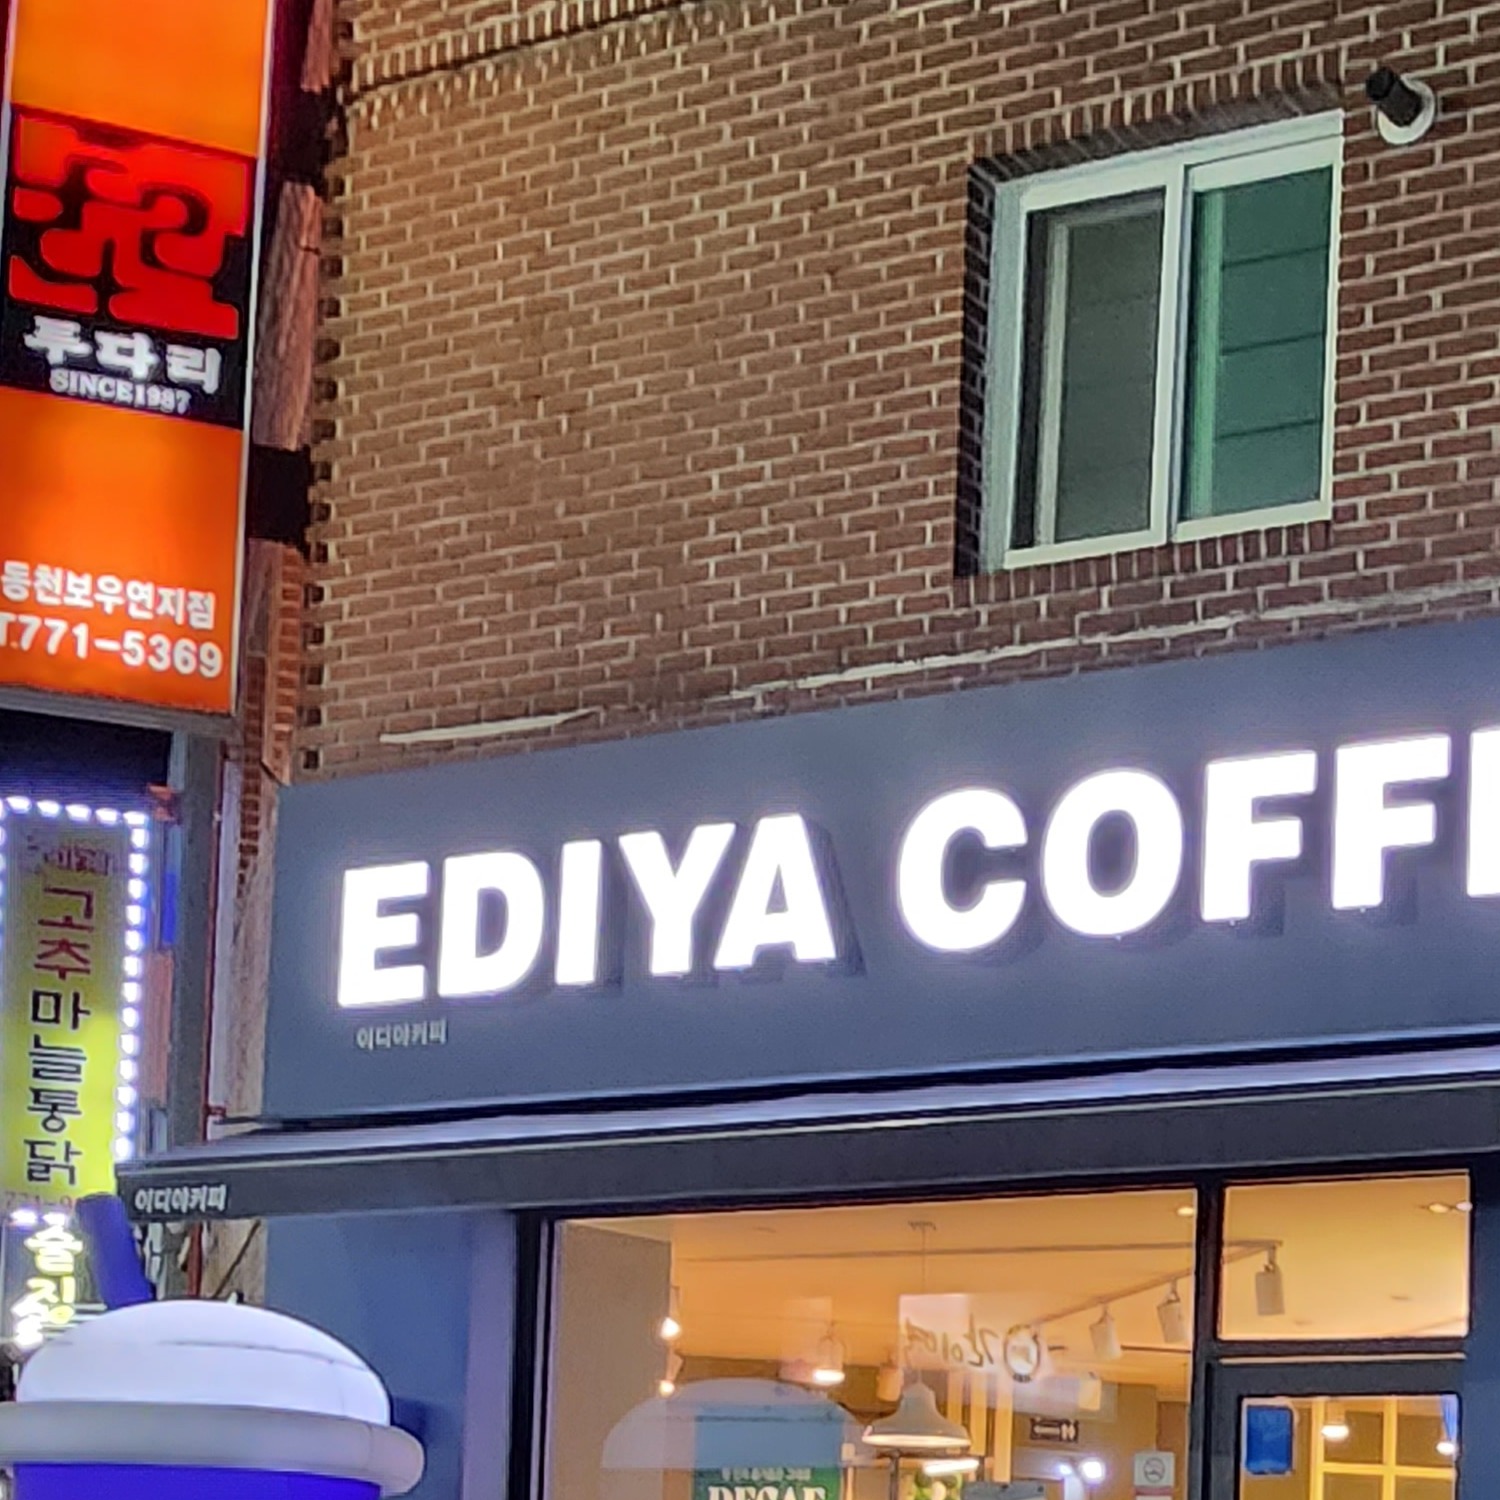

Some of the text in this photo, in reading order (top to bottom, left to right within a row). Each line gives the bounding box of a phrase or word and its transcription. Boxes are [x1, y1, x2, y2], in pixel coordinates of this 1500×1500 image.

[336, 812, 837, 1008] EDIYA
[356, 1016, 447, 1051] 이디야커피
[134, 1183, 228, 1214] 이디야커피
